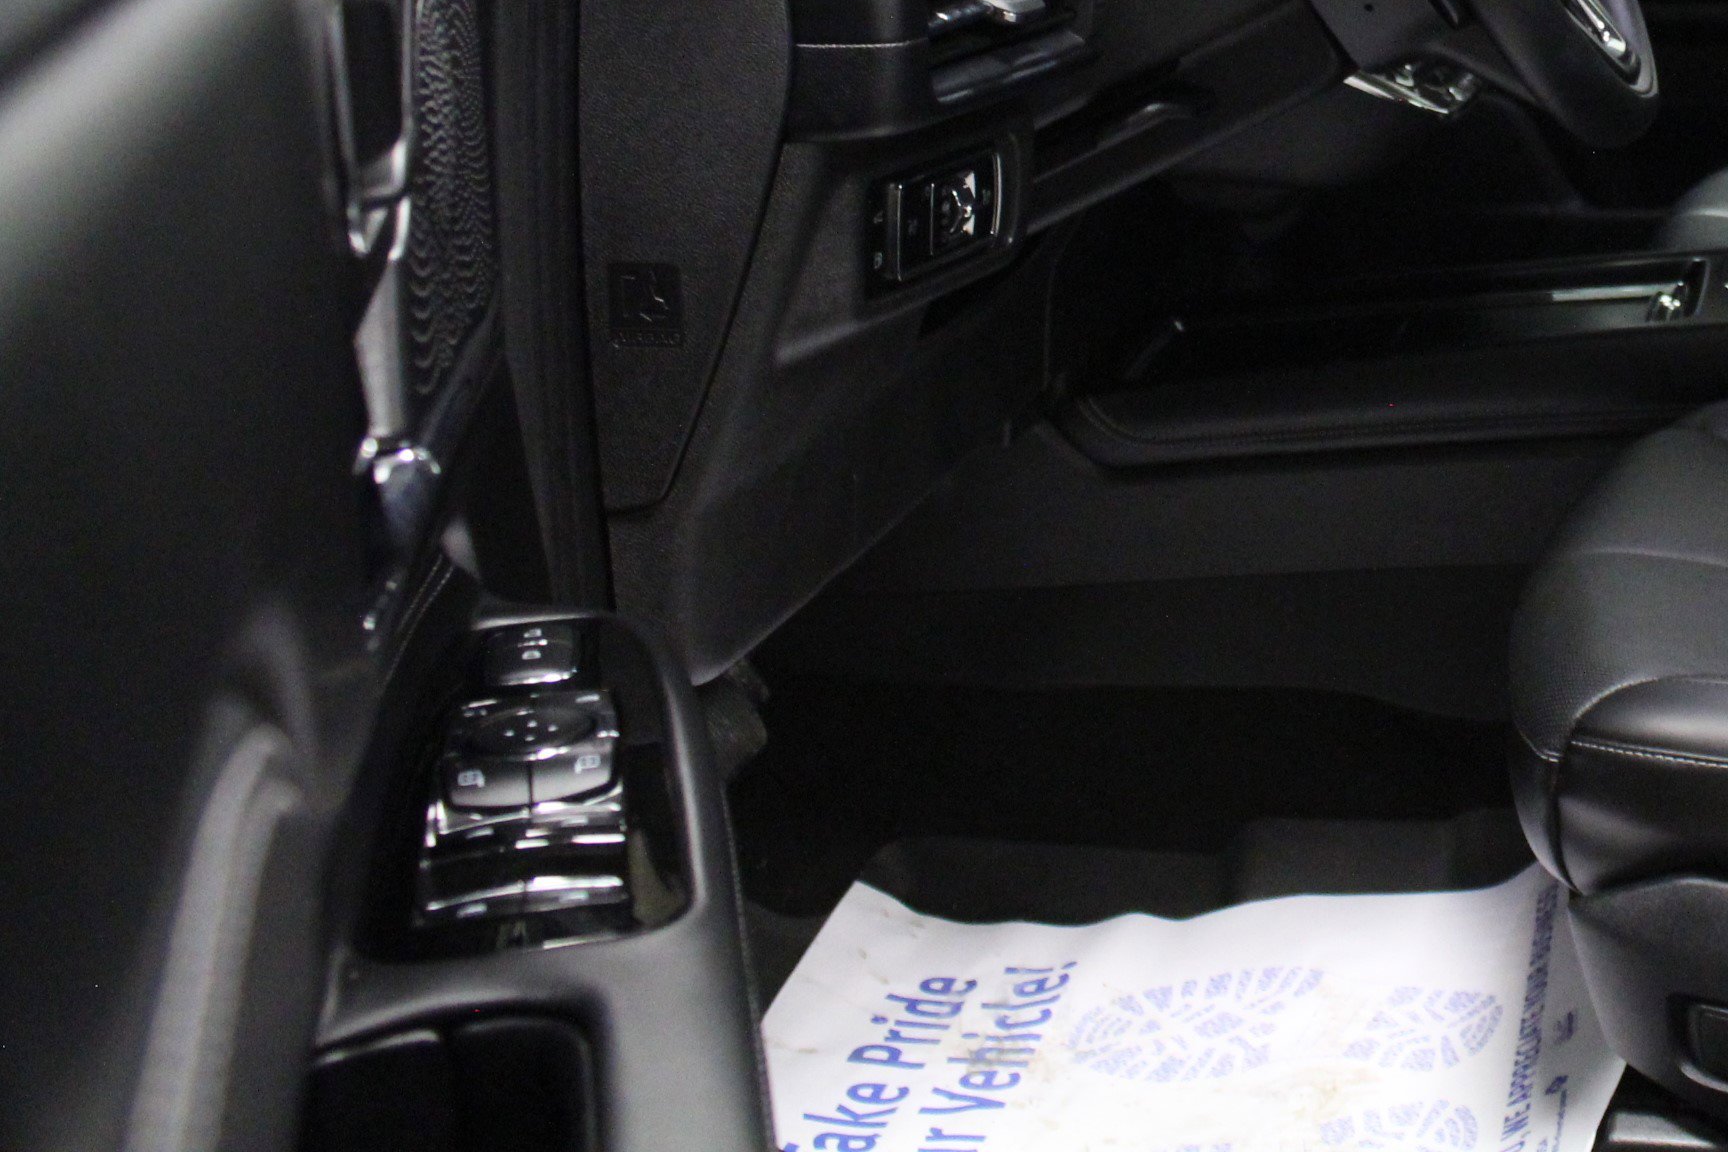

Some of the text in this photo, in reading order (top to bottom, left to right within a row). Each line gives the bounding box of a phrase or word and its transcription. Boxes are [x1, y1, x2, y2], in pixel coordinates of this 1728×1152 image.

[847, 976, 978, 1070] Pride
[917, 960, 1078, 1116] Vehicle!
[1500, 1103, 1531, 1142] WE
